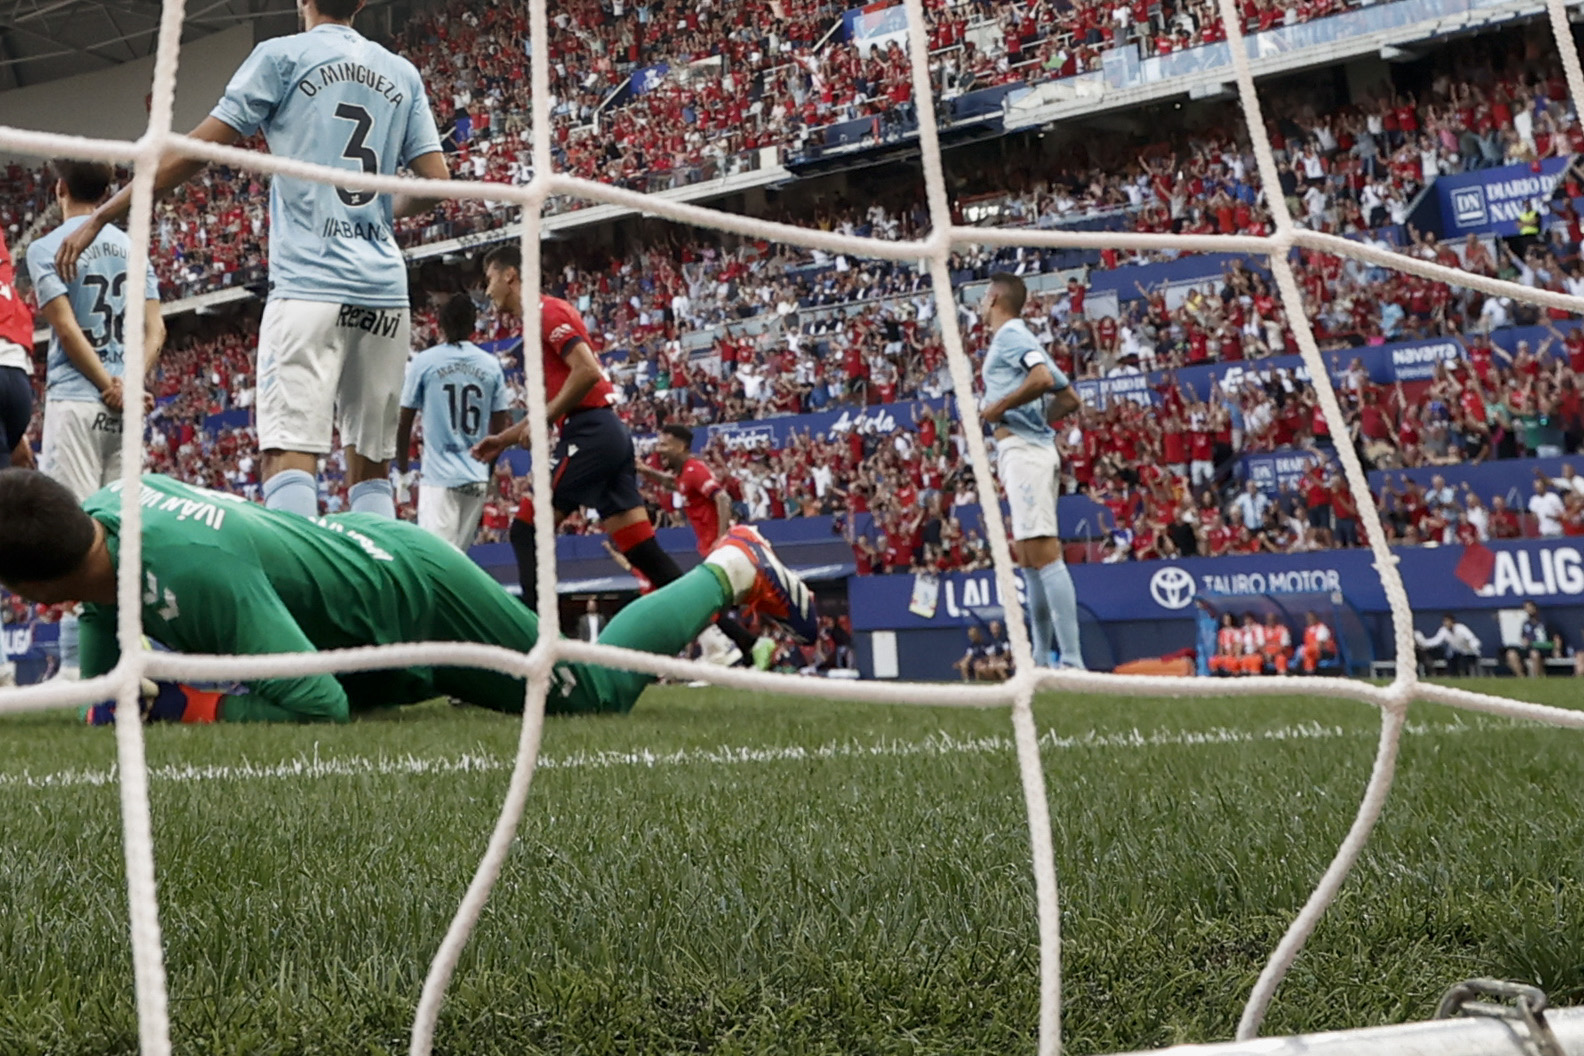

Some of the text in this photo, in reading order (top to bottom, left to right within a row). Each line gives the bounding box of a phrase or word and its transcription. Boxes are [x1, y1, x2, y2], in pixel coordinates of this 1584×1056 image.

[333, 102, 378, 207] 3
[442, 384, 483, 436] 16
[1202, 570, 1340, 594] TAURO MOTOR
